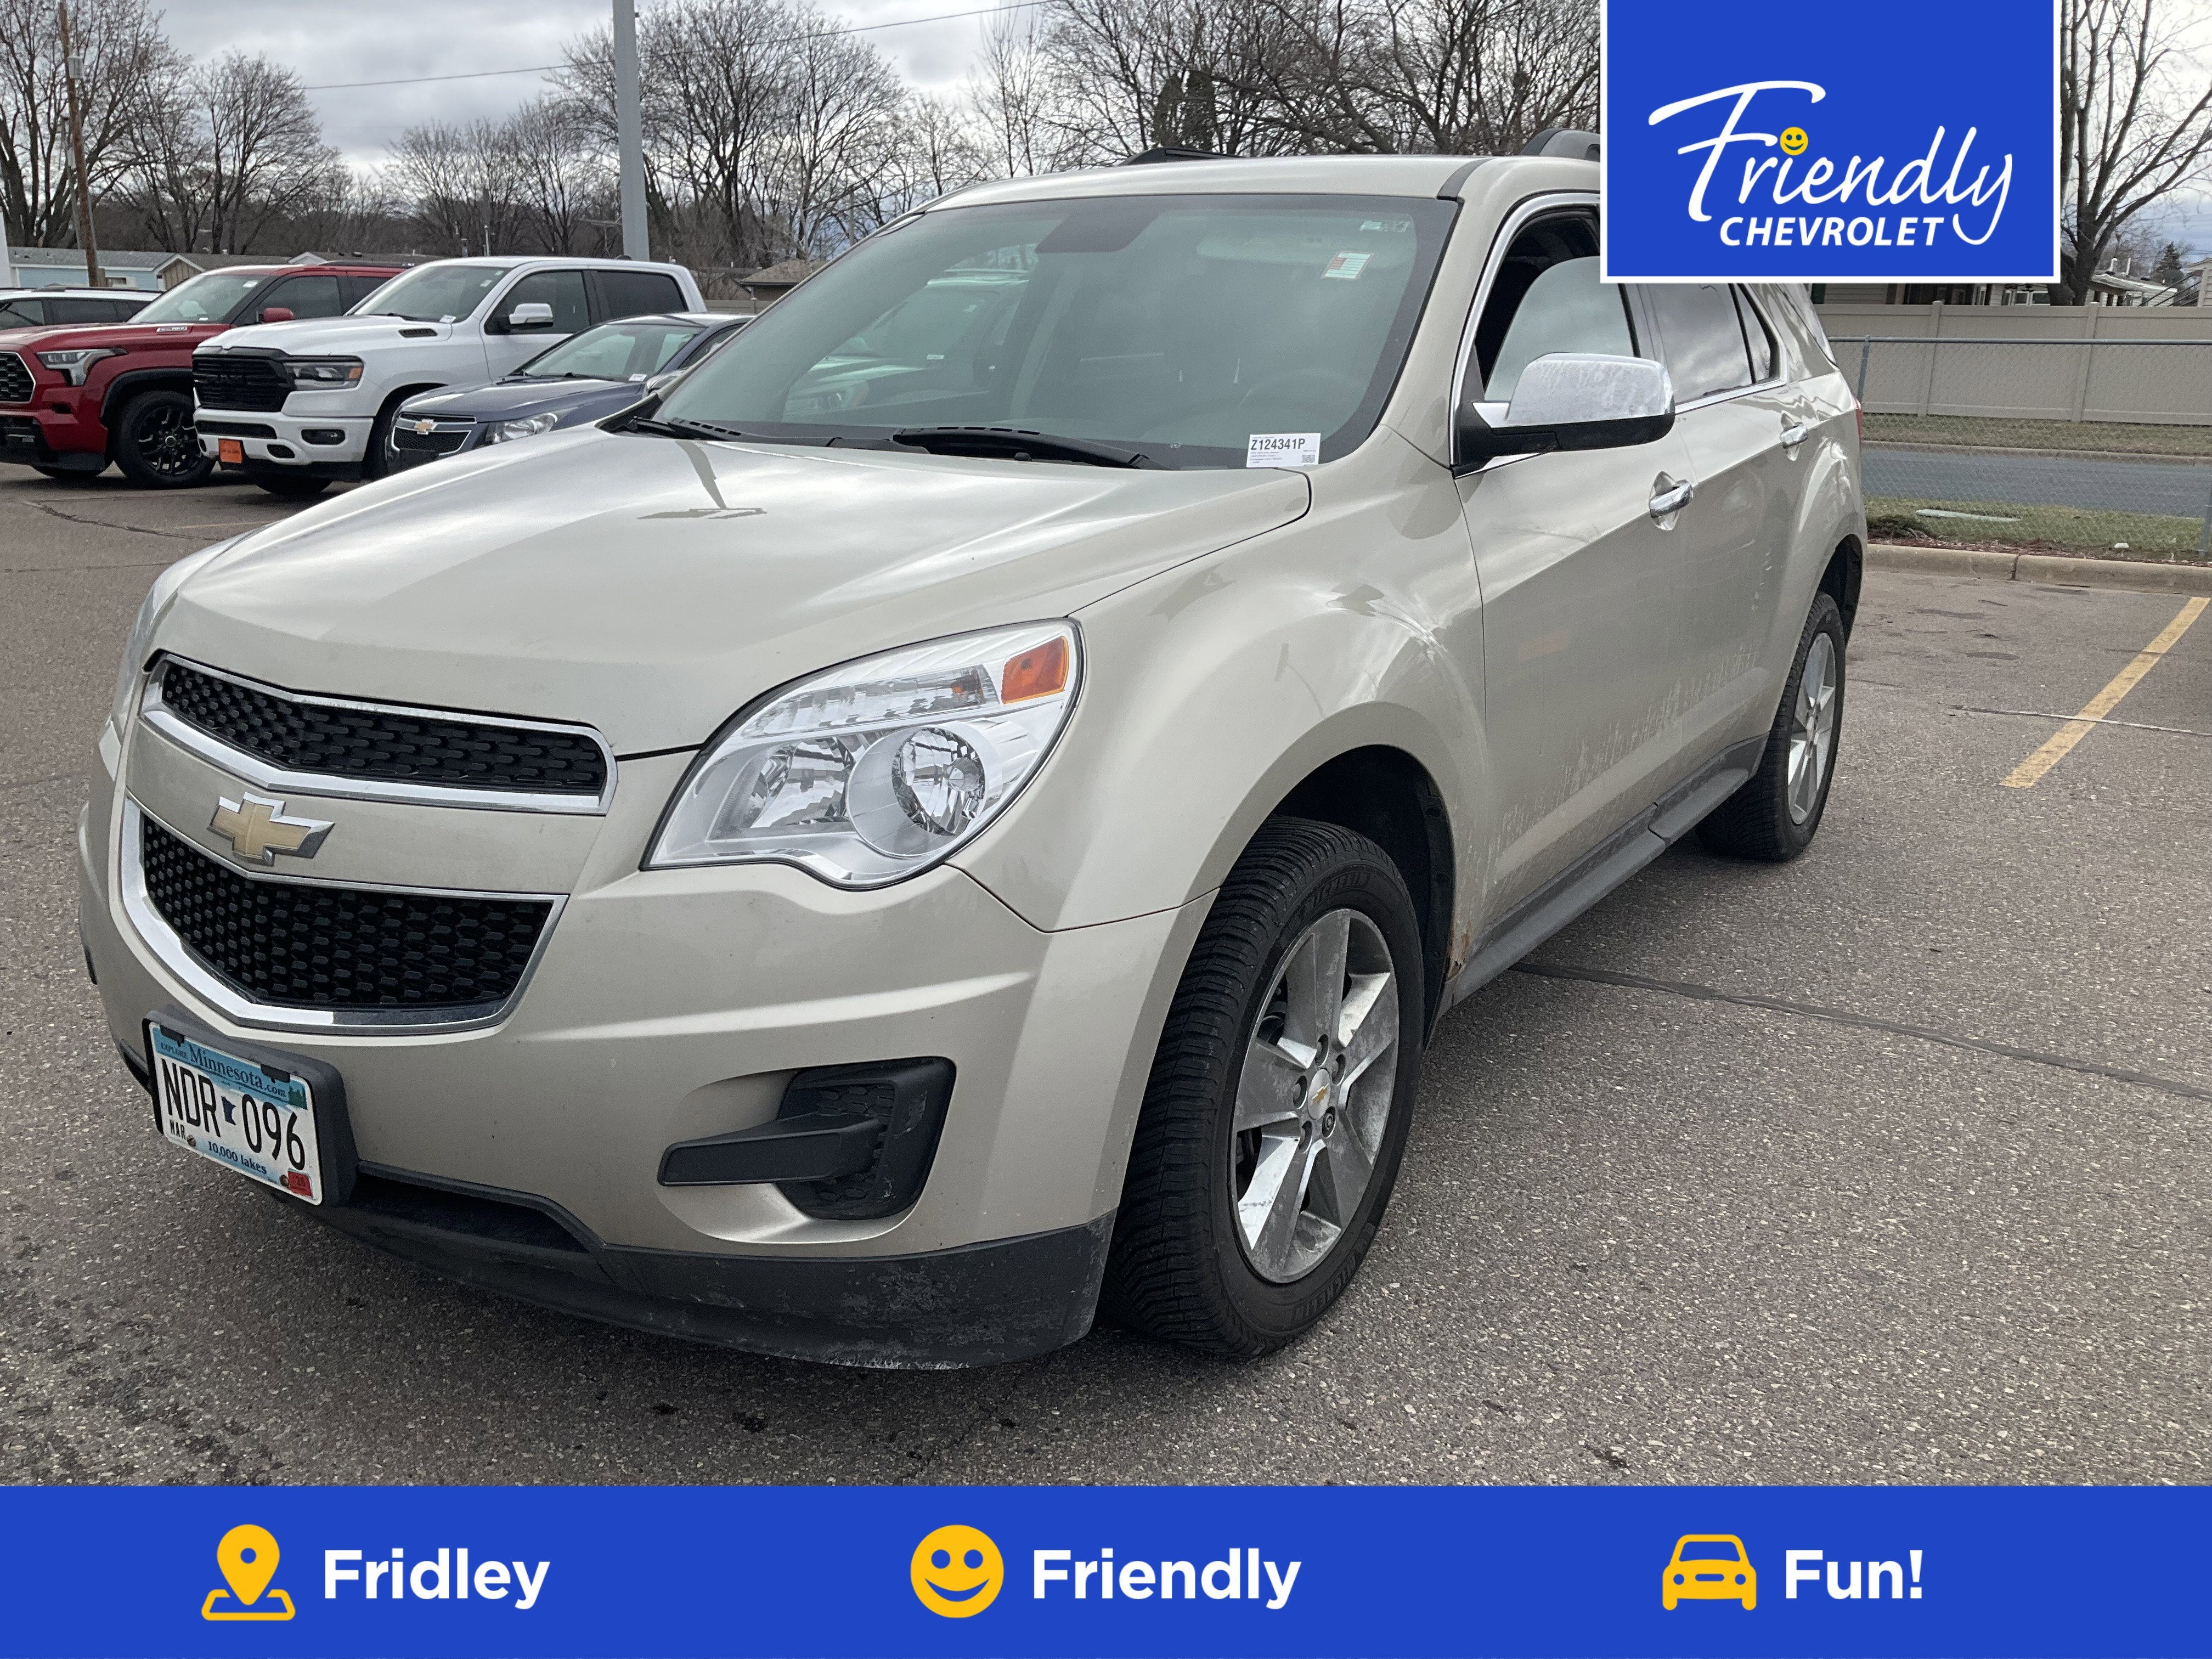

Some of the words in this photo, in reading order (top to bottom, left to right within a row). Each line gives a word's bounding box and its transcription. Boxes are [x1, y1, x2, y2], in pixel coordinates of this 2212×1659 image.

[1251, 438, 1306, 450] Z124341P
[161, 1058, 221, 1137] NDR
[242, 1094, 305, 1170] 096
[170, 1119, 186, 1140] MAR
[207, 1141, 238, 1163] 10,000
[240, 1154, 267, 1175] lakes
